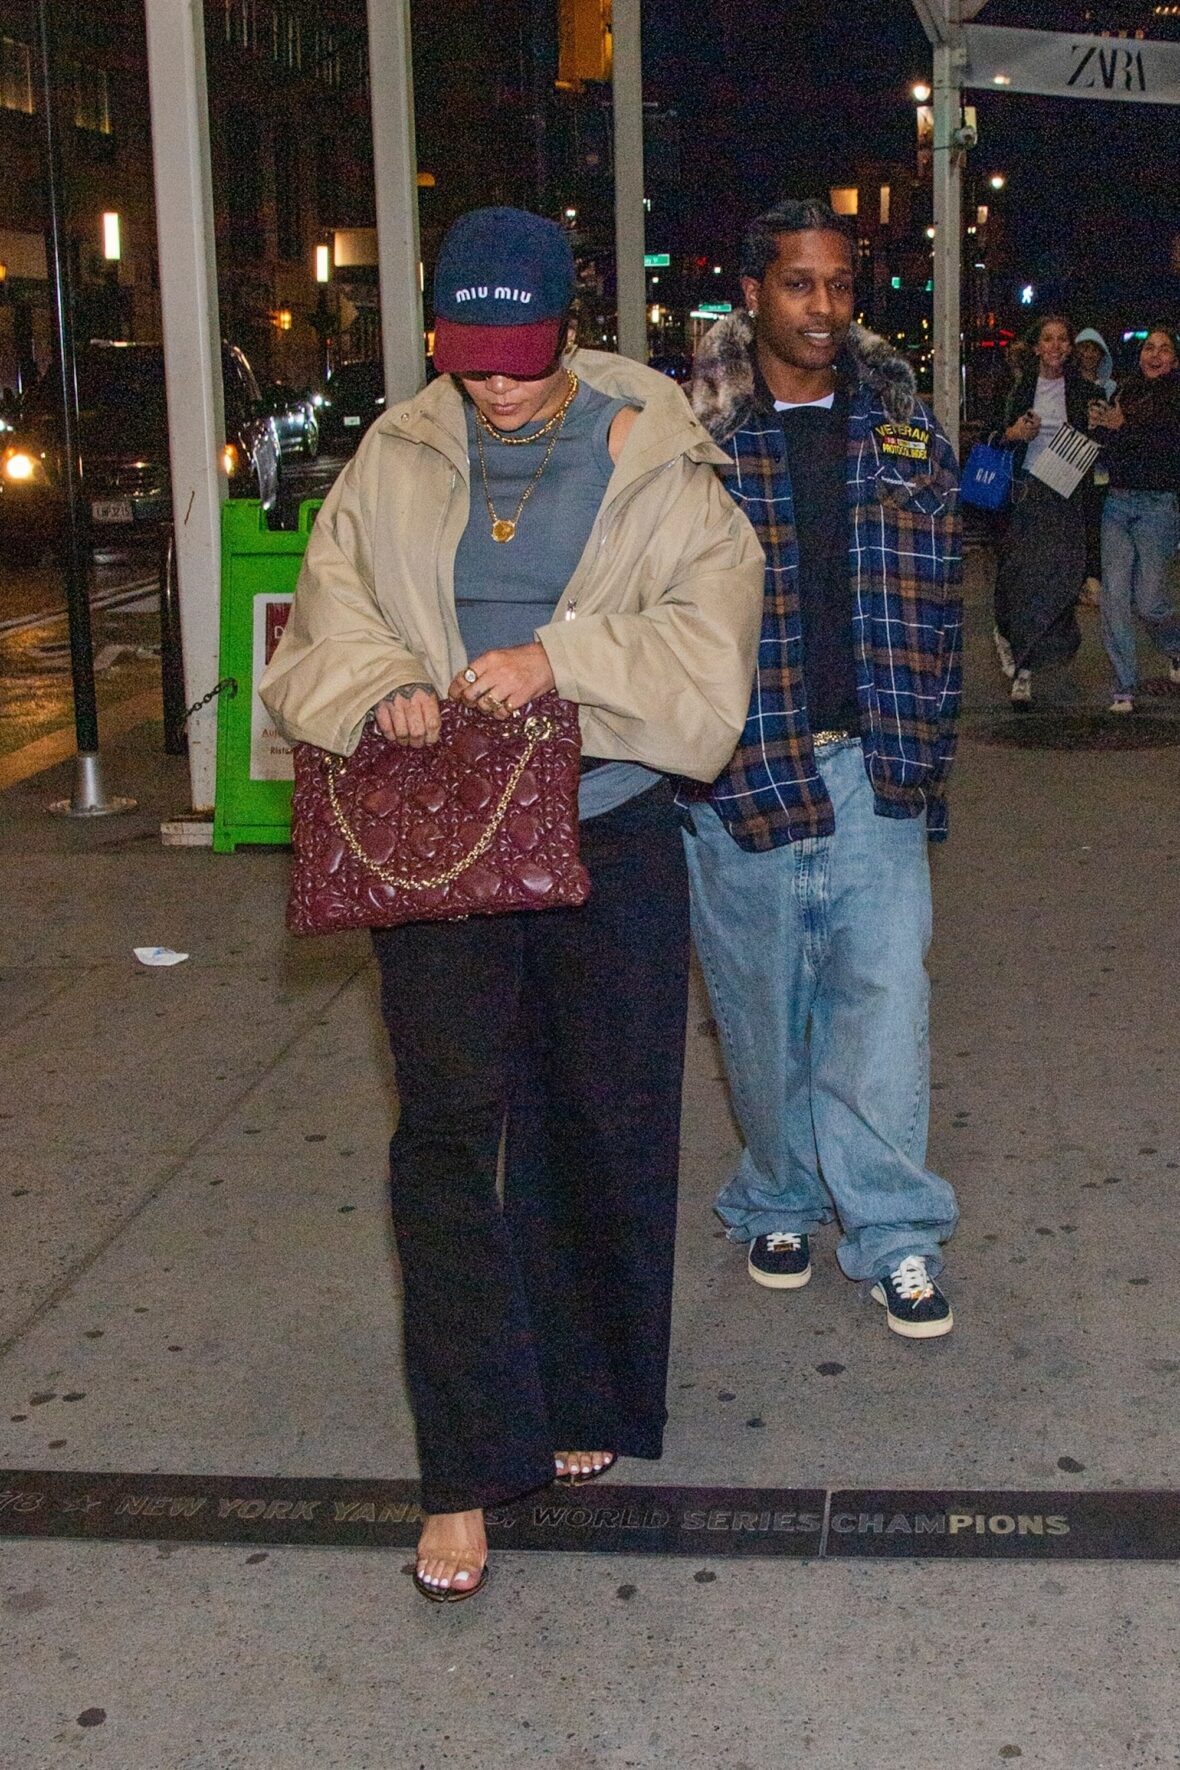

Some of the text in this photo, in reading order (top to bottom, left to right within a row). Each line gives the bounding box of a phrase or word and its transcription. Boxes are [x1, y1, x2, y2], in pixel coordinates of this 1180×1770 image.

[1066, 45, 1146, 92] ZARA
[875, 424, 929, 443] VETERAN
[975, 468, 997, 485] GAP
[114, 1495, 208, 1517] NEW
[217, 1498, 321, 1521] YORK
[532, 1506, 671, 1529] WORLD
[680, 1509, 821, 1532] SERIES
[831, 1513, 1071, 1535] CHAMPIONS
